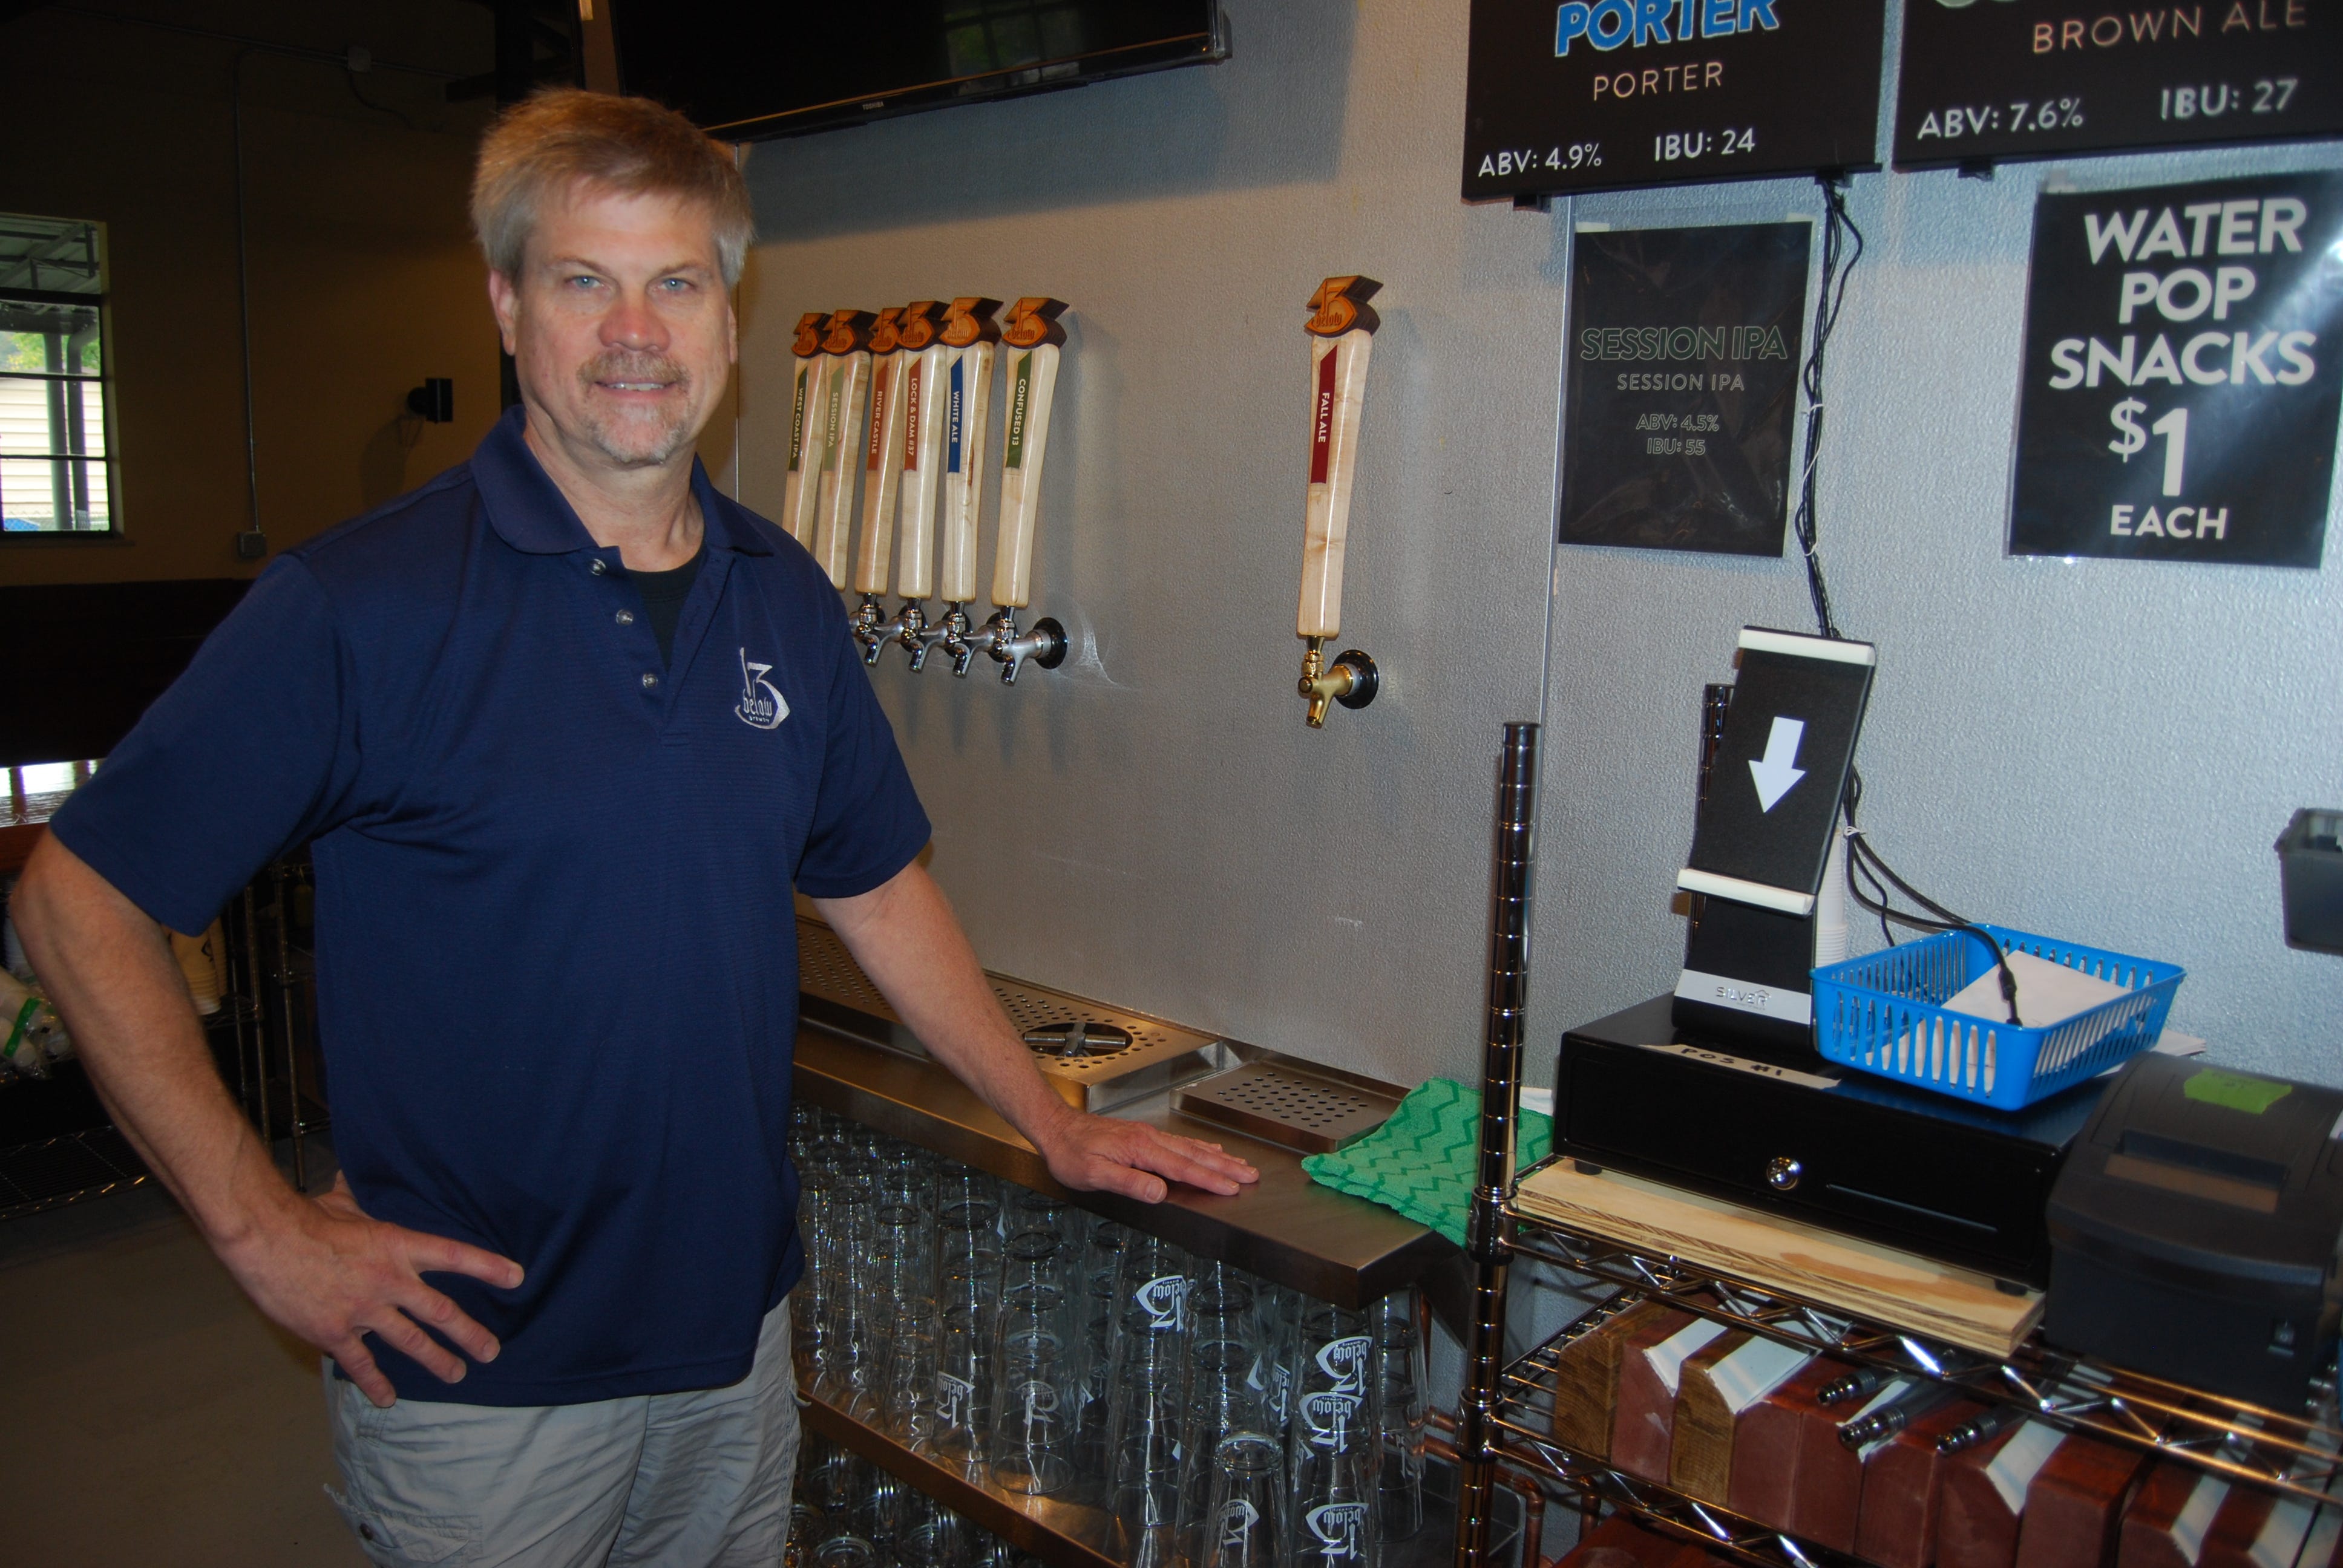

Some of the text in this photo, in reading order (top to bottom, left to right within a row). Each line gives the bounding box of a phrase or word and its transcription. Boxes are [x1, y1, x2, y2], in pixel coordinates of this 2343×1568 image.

[1555, 0, 1779, 57] PORTER
[2034, 0, 2306, 54] BROWN ALE
[1593, 62, 1723, 100] PORTER
[2161, 79, 2298, 119] IBU: 27
[1918, 99, 2083, 139] ABV: 7.6%
[1478, 143, 1602, 177] ABV: 4.9%
[1655, 128, 1755, 162] IBU: 24
[2085, 198, 2307, 265] WATER
[2119, 267, 2255, 324] POP
[1581, 326, 1788, 360] SESSION IPA
[2049, 331, 2317, 390] SNACKS
[1617, 374, 1745, 391] SESSION IPA
[830, 392, 839, 430] SESSION
[1012, 379, 1026, 446] CONFUSED 13
[1318, 393, 1330, 443] FALL ALE
[1636, 414, 1719, 432] ABV: 4.5%
[1647, 438, 1705, 456] IBU: 55
[2108, 397, 2187, 496] $1
[2110, 505, 2227, 539] EACH
[742, 679, 772, 717] below
[1715, 987, 1767, 1007] SILVER
[1681, 1048, 1782, 1076] POS #1
[1333, 1342, 1367, 1373] below
[1312, 1399, 1352, 1428] below
[1323, 1508, 1362, 1538] below
